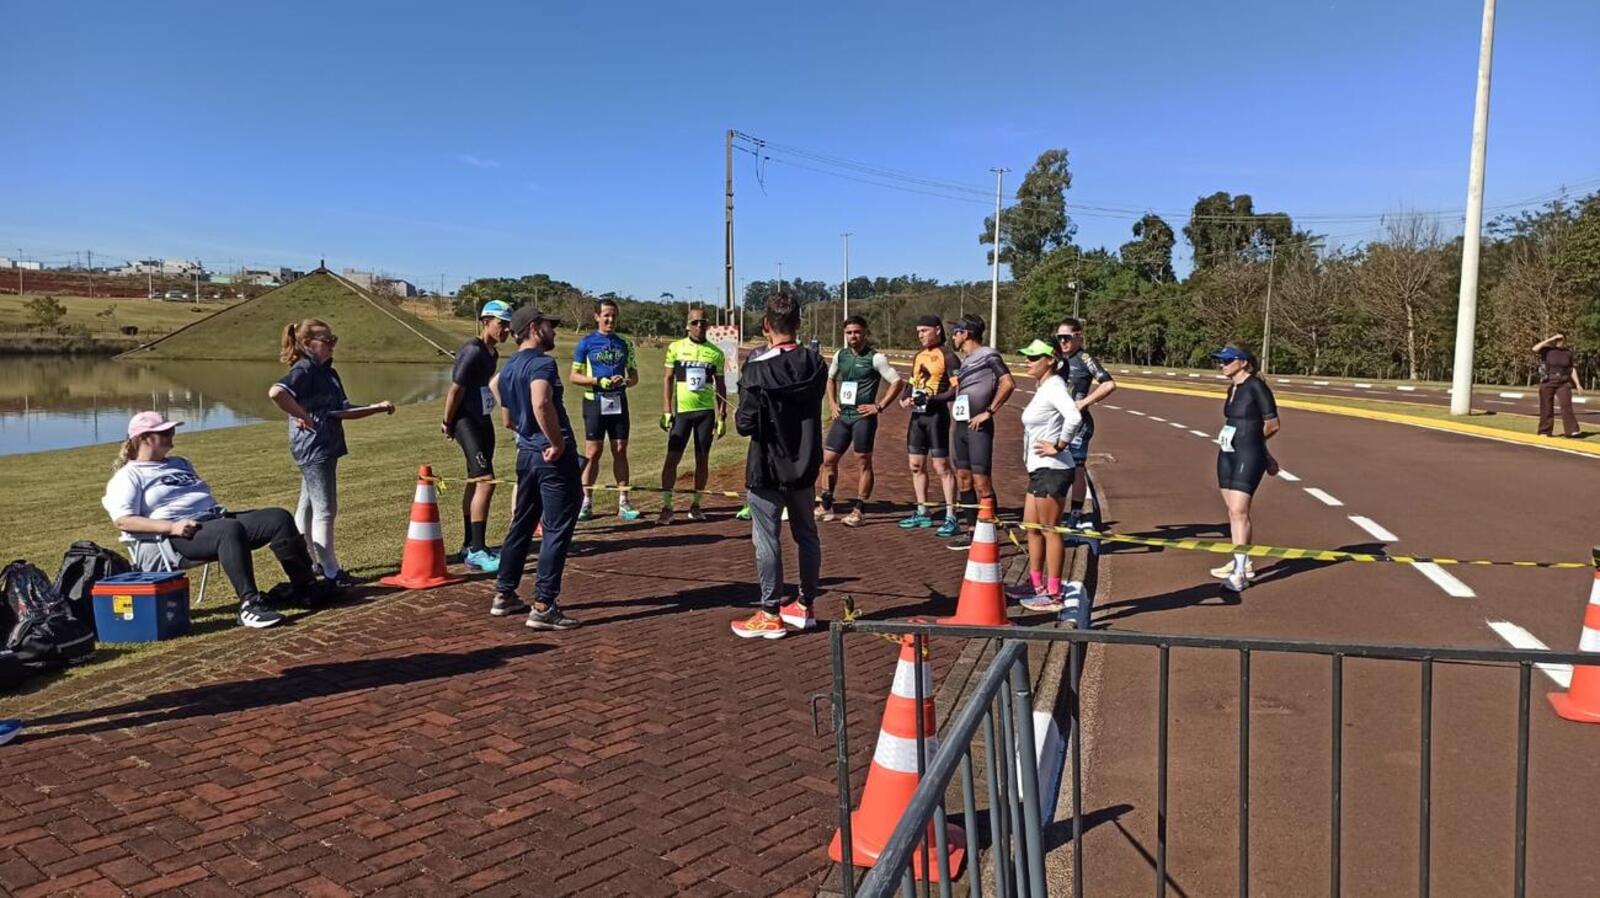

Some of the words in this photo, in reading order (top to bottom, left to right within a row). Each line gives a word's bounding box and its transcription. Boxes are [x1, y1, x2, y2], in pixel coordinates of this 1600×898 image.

[690, 377, 702, 386] 37
[843, 390, 852, 400] 19
[955, 406, 965, 415] 22
